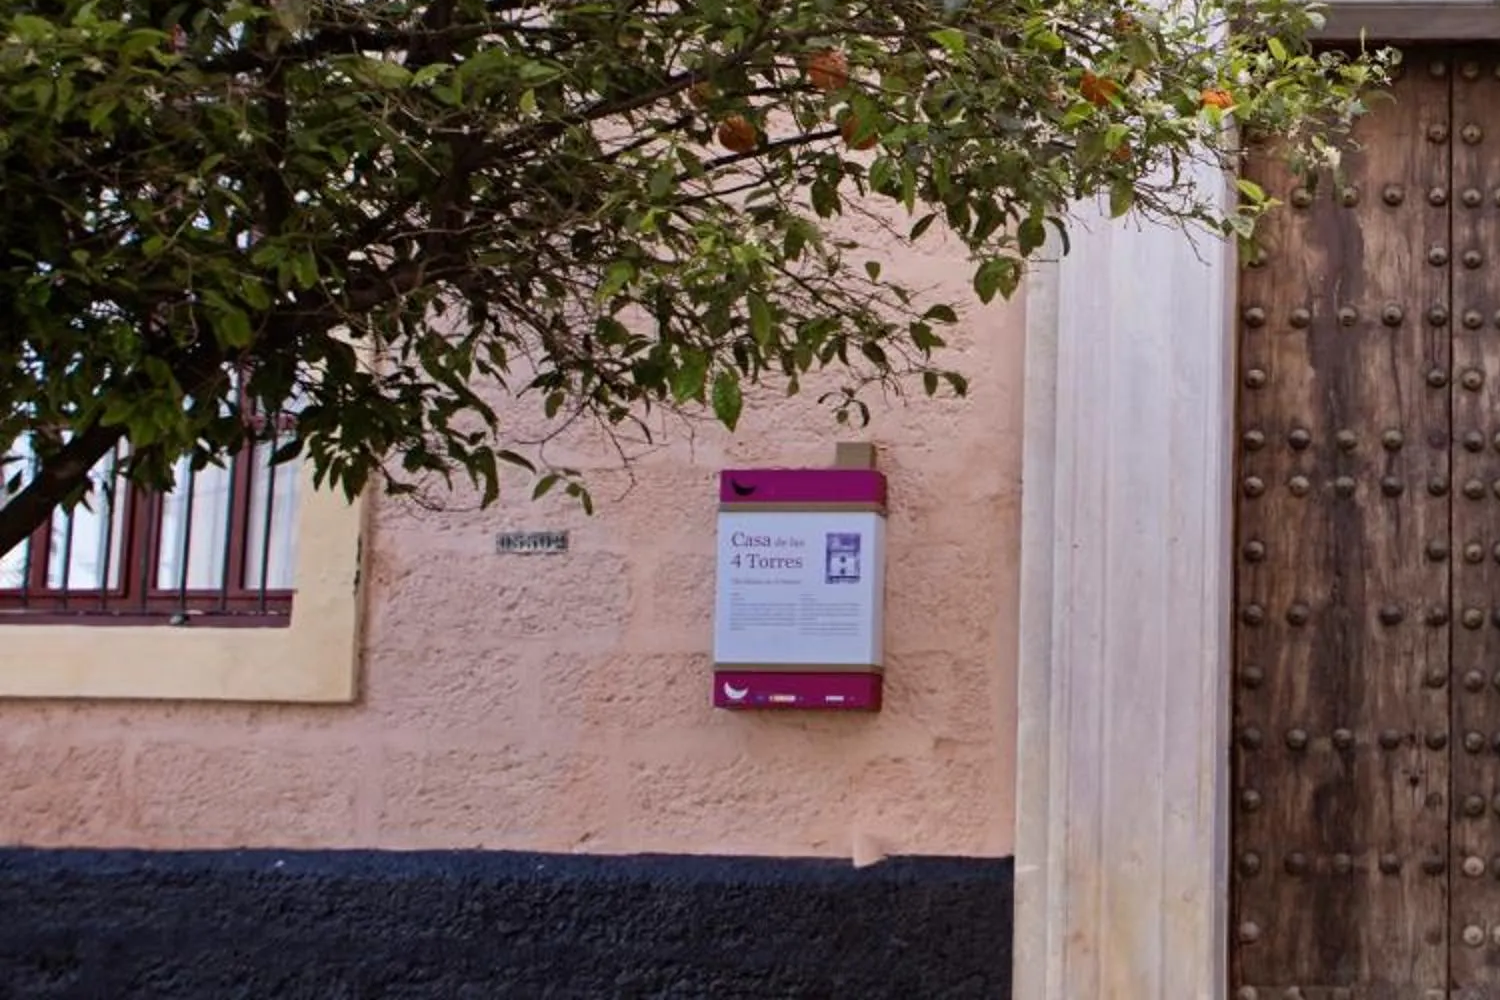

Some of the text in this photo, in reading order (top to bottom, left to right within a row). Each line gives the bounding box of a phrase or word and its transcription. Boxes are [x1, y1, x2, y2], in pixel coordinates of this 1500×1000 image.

[731, 530, 771, 548] Casa
[730, 553, 803, 569] 4 Torres
